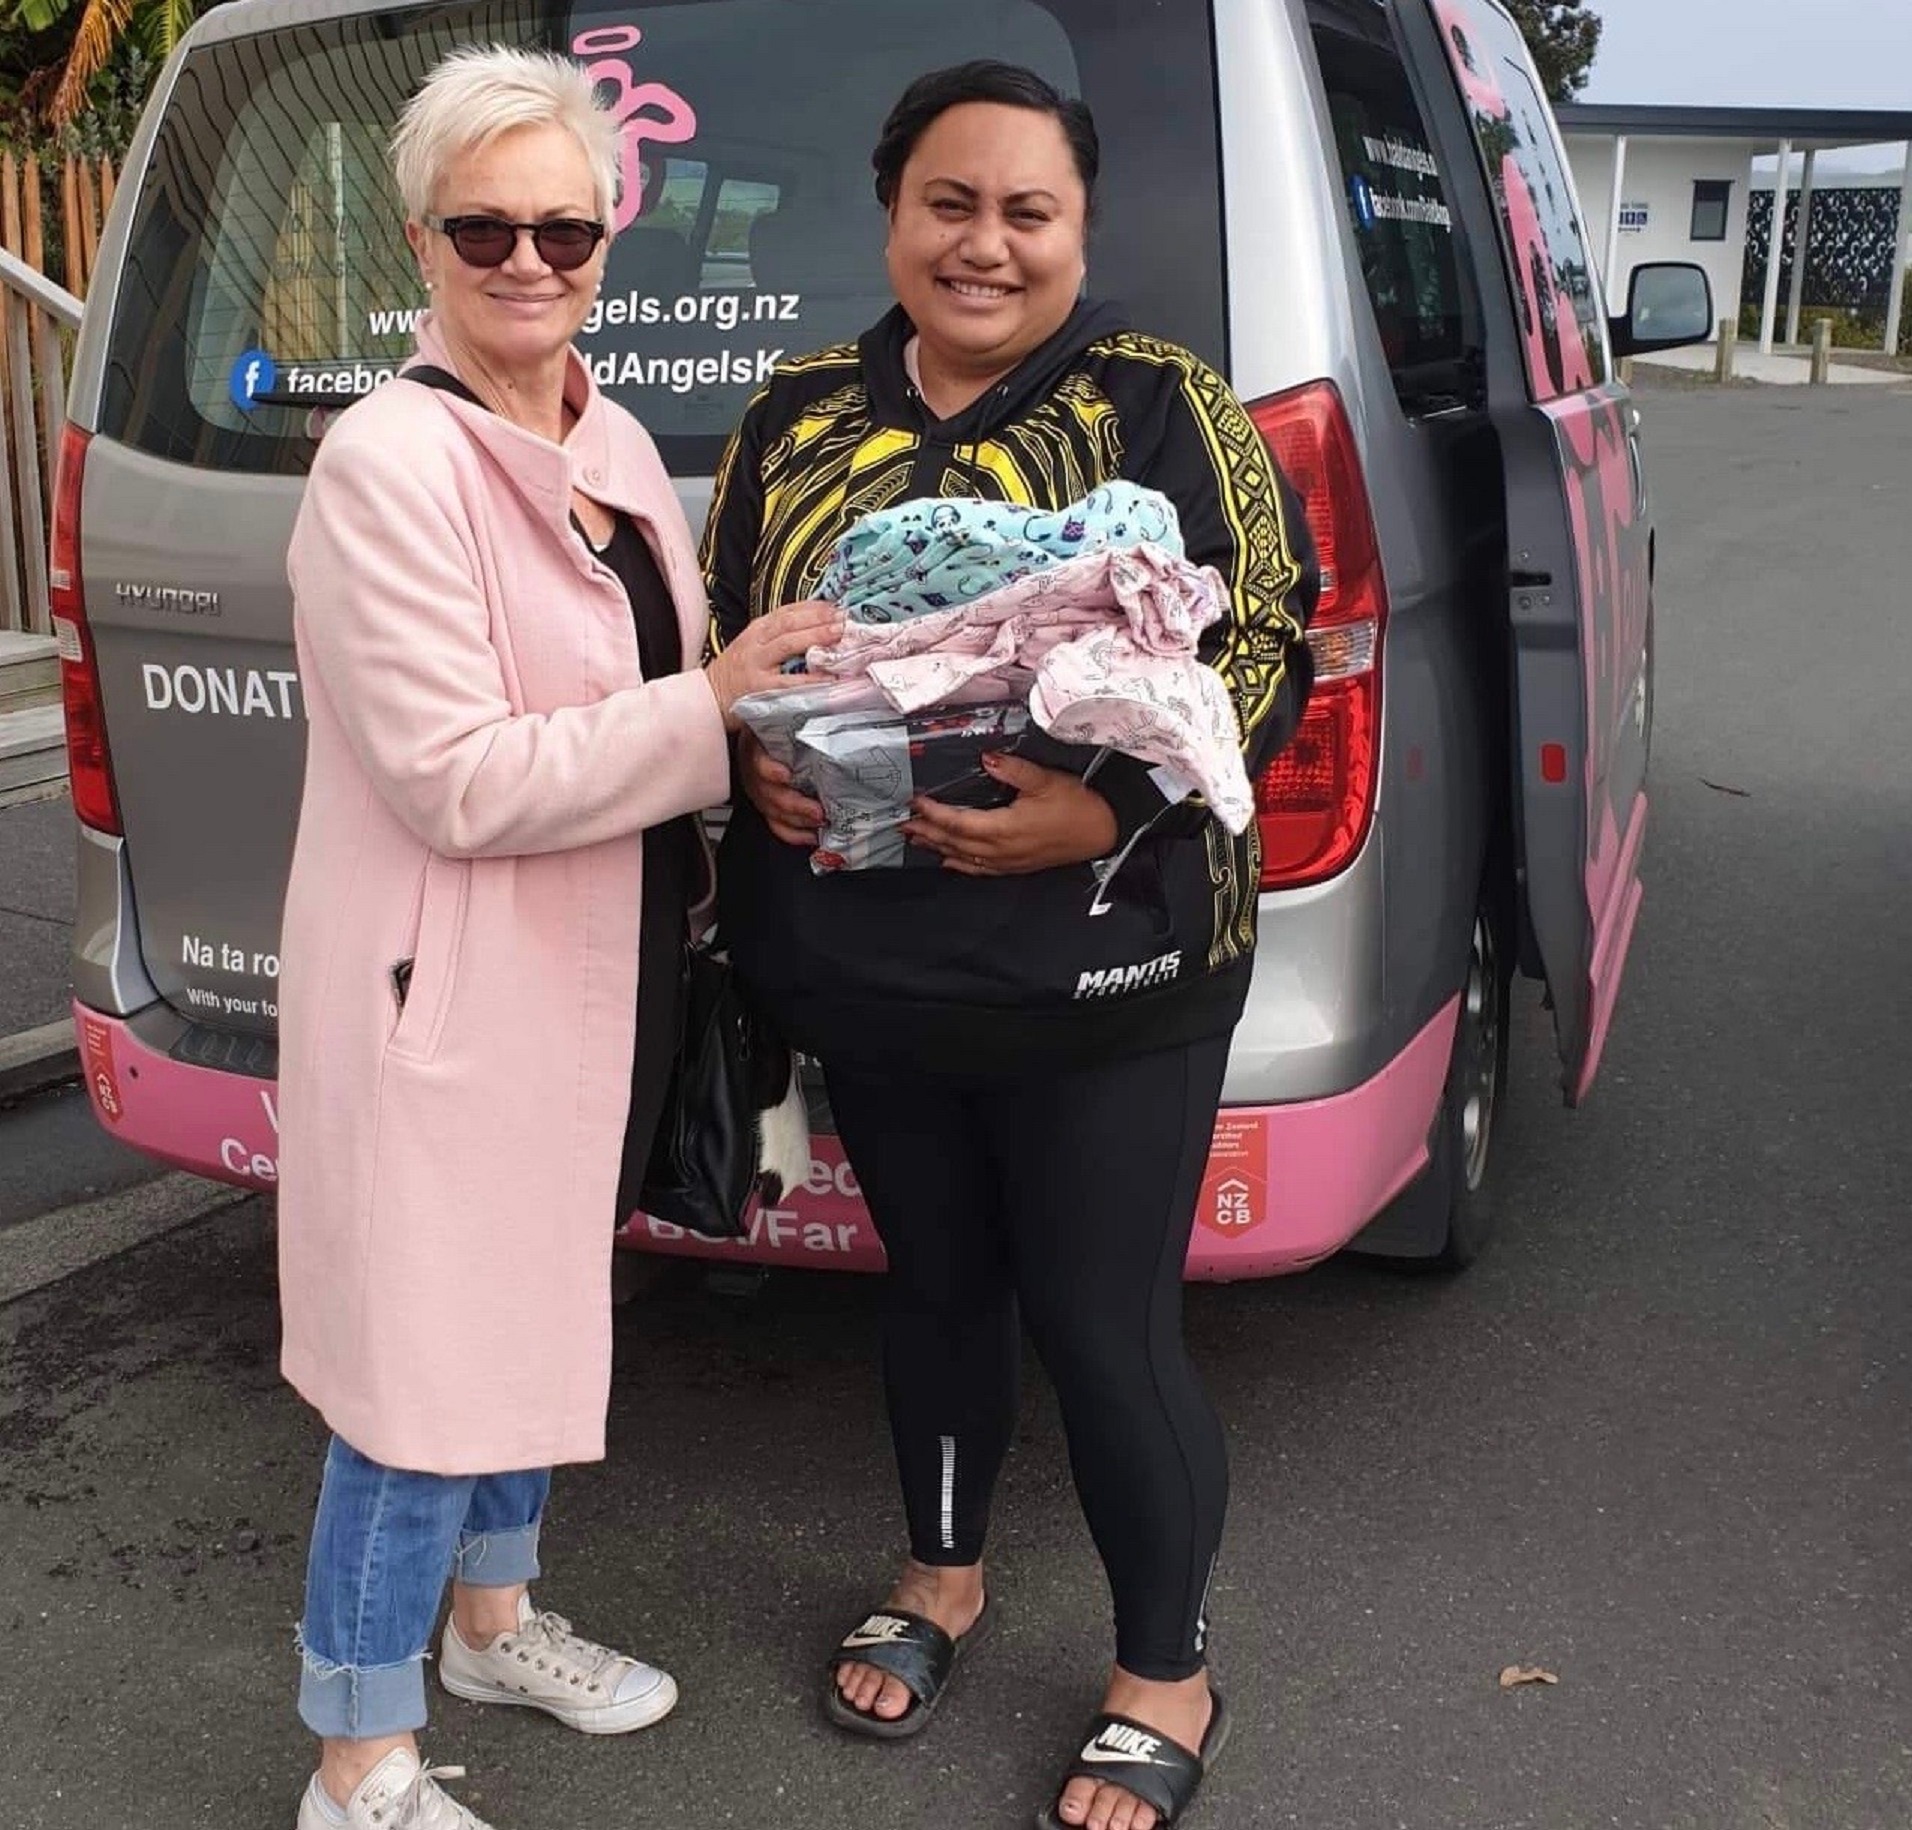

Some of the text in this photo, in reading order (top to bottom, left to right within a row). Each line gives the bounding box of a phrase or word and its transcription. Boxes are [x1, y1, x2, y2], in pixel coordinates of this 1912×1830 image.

[369, 291, 800, 335] ww gels.org.nz
[286, 364, 394, 395] facebo
[143, 664, 298, 719] DONAT
[182, 934, 280, 978] Na ta ro
[1077, 950, 1182, 991] MANTIS
[186, 988, 220, 1009] With
[223, 996, 258, 1014] your
[221, 1138, 279, 1182] Ce
[1216, 1210, 1251, 1225] CB
[1217, 1193, 1249, 1209] NZ
[860, 1615, 910, 1639] NIKE
[1098, 1723, 1162, 1759] NIKE
